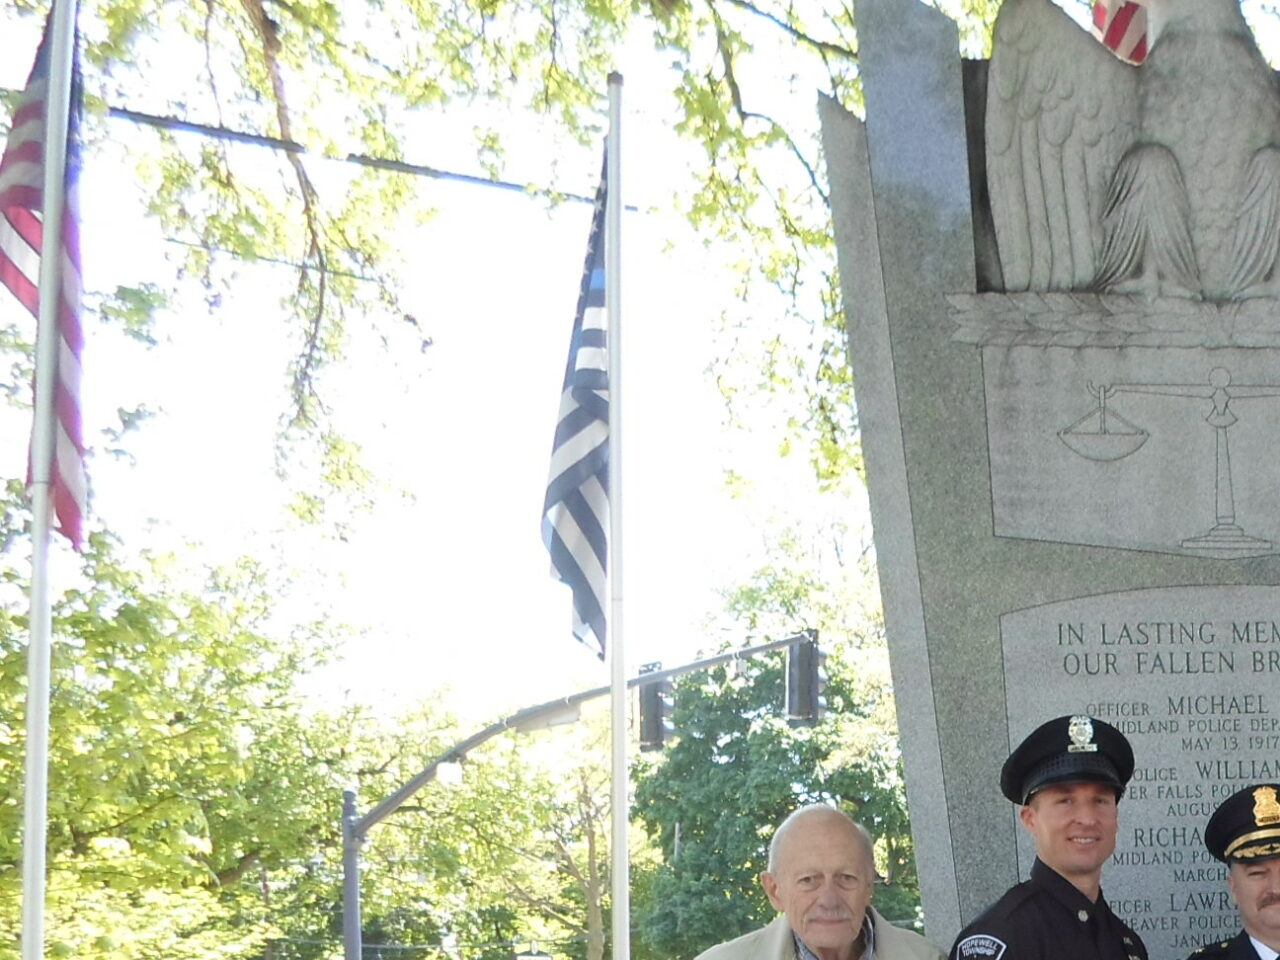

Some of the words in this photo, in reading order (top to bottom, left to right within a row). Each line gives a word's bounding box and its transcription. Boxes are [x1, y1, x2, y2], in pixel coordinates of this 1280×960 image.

[1058, 622, 1085, 646] IN
[1101, 621, 1217, 646] LASTING
[1063, 651, 1120, 676] OUR
[1136, 650, 1235, 675] FALLEN
[1086, 702, 1150, 717] OFFICER
[1168, 695, 1269, 716] MICHAEL
[1110, 719, 1179, 734] MIDLAND
[1188, 718, 1241, 733] POLICE
[1181, 737, 1212, 752] MAY
[1249, 736, 1280, 750] 1917
[1133, 767, 1178, 782] OLICE
[1158, 784, 1203, 799] FALLS
[1168, 802, 1222, 817] AUGUS
[1134, 826, 1203, 848] RICHA
[1113, 850, 1184, 866] MIDLAND
[1174, 868, 1227, 882] MARCH
[1109, 899, 1152, 913] FICER
[1189, 915, 1242, 929] POLICE
[961, 939, 997, 950] HOPEWELL
